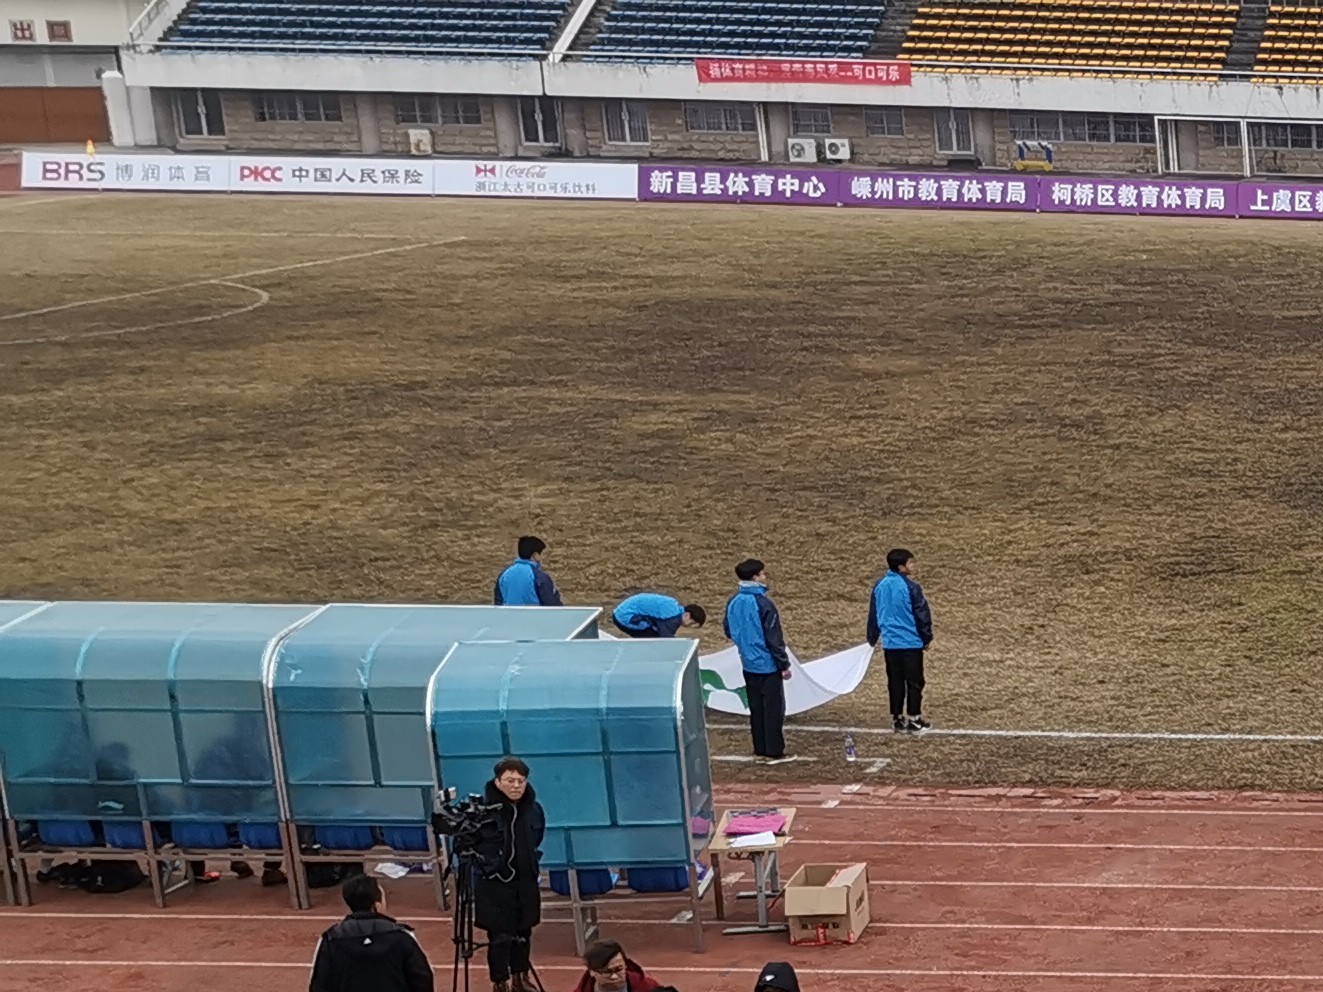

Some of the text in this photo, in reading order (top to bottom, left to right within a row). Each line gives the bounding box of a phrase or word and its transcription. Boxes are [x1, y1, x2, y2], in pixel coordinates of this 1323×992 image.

[42, 161, 105, 182] BRS
[239, 165, 283, 182] PICC
[291, 166, 423, 185] 中国人民保险
[475, 181, 596, 195] 浙江太古可口可乐饮料
[649, 170, 826, 198] 新昌县体育中心
[851, 176, 1027, 204] 嵊州市教育体育局
[1052, 182, 1226, 211] 柯桥区教育体育局
